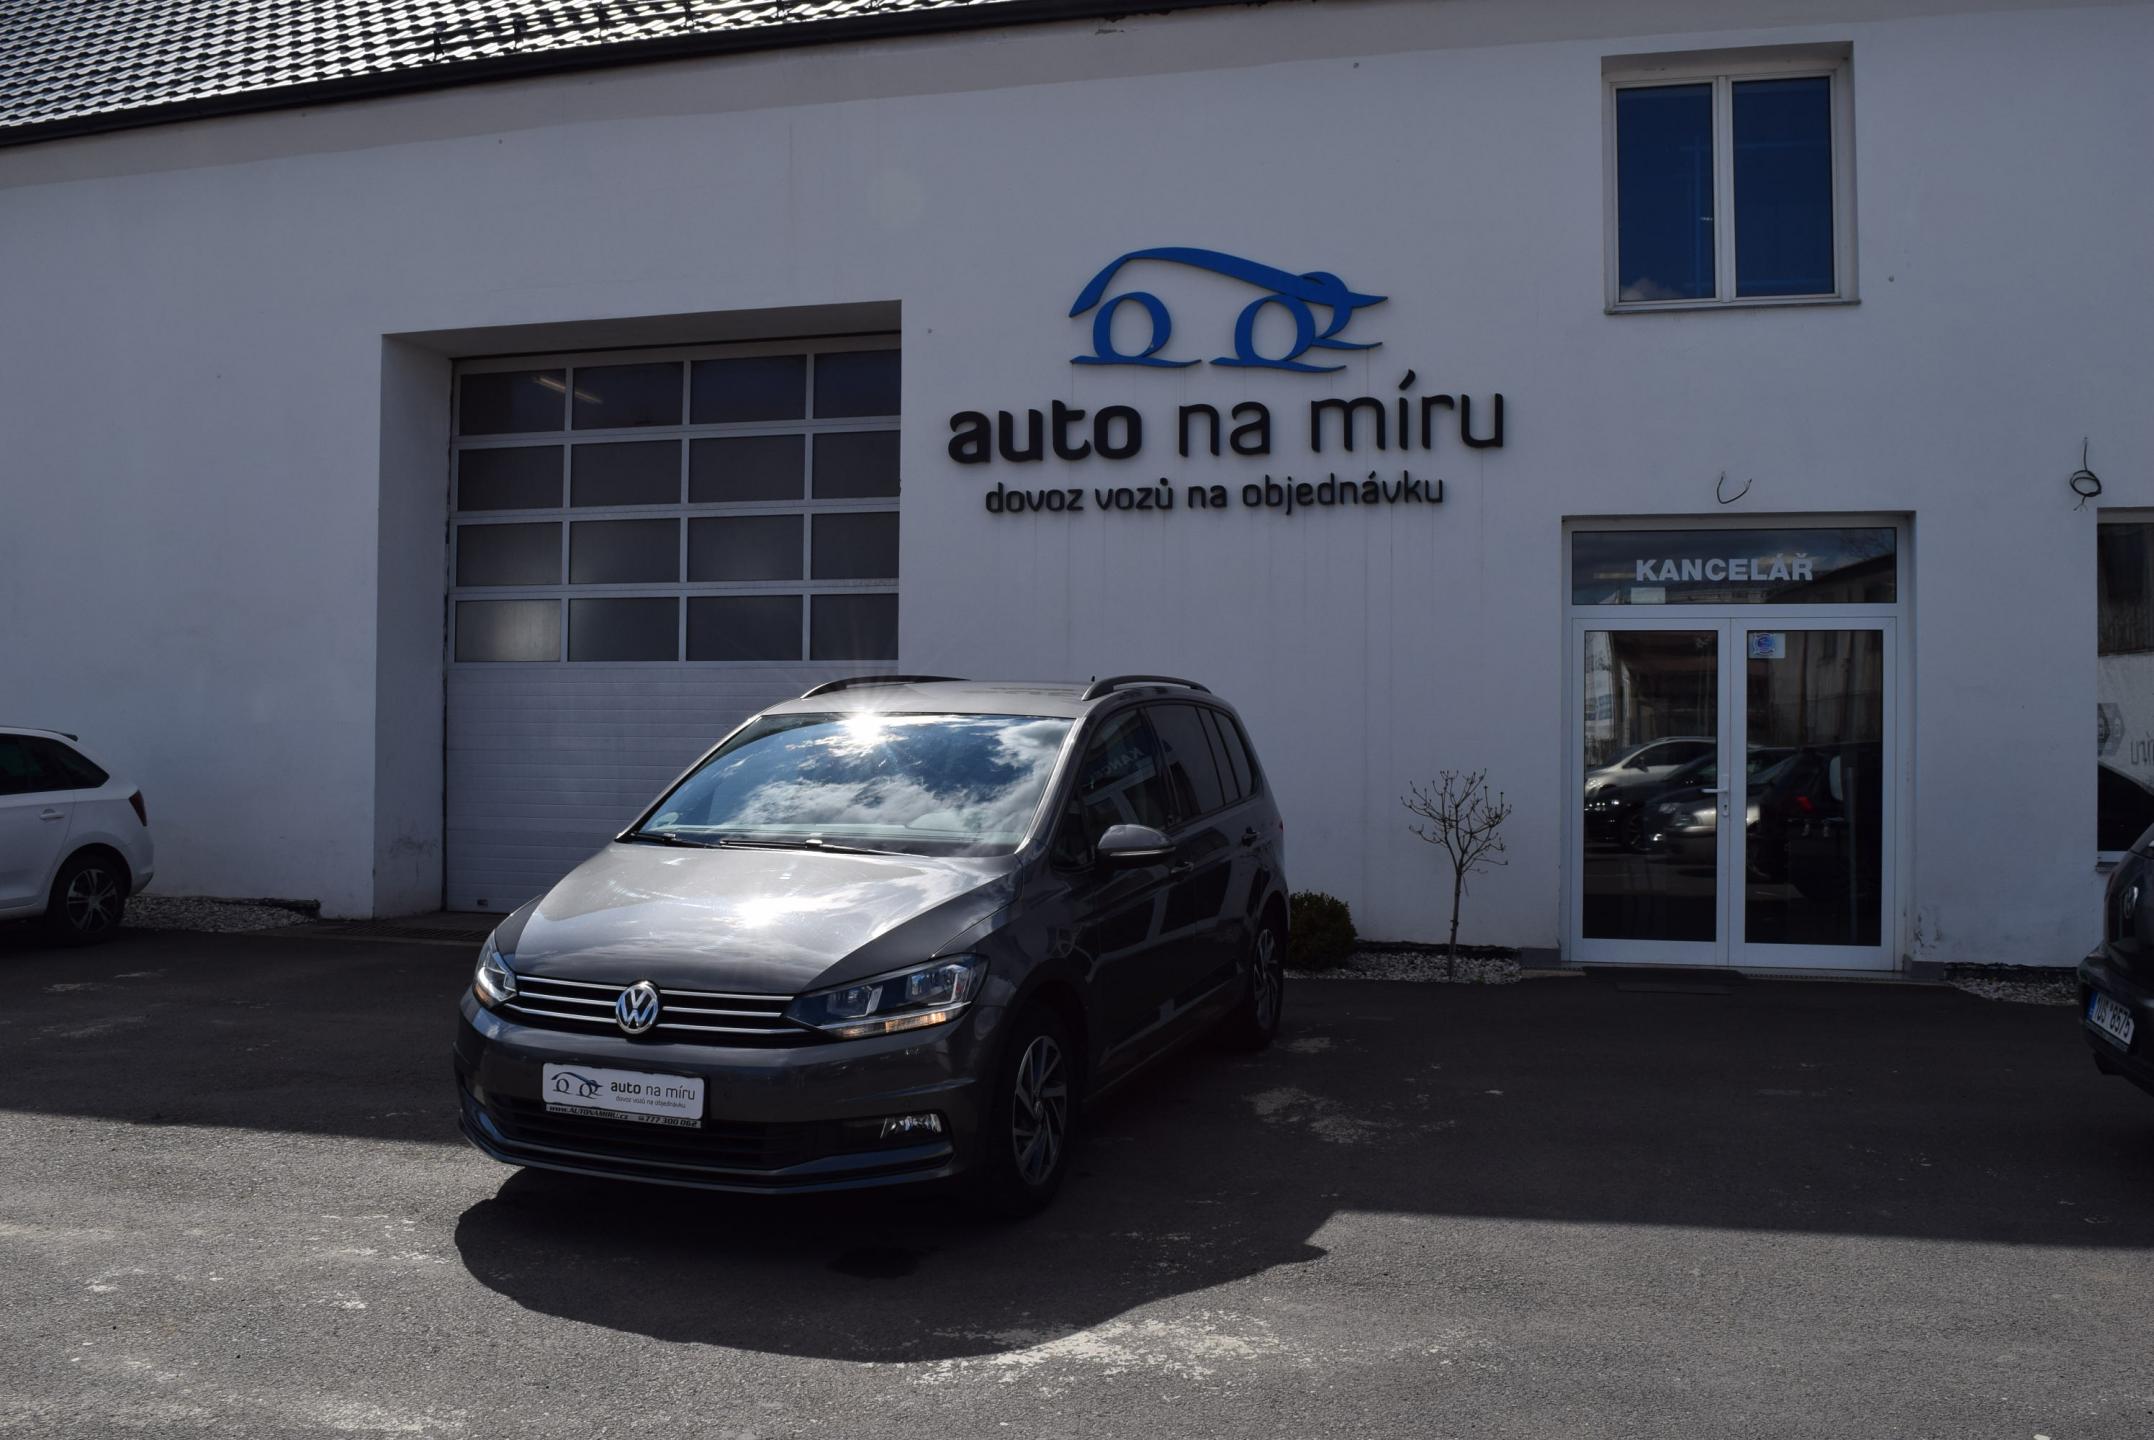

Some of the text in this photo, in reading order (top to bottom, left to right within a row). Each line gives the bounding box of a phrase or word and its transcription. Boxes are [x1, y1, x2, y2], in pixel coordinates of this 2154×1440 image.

[948, 369, 1504, 466] auto na míru
[986, 469, 1444, 516] dovoz vozů na objednávku
[1635, 552, 1814, 582] KANCELÁŘ
[610, 1081, 696, 1101] auto na míru
